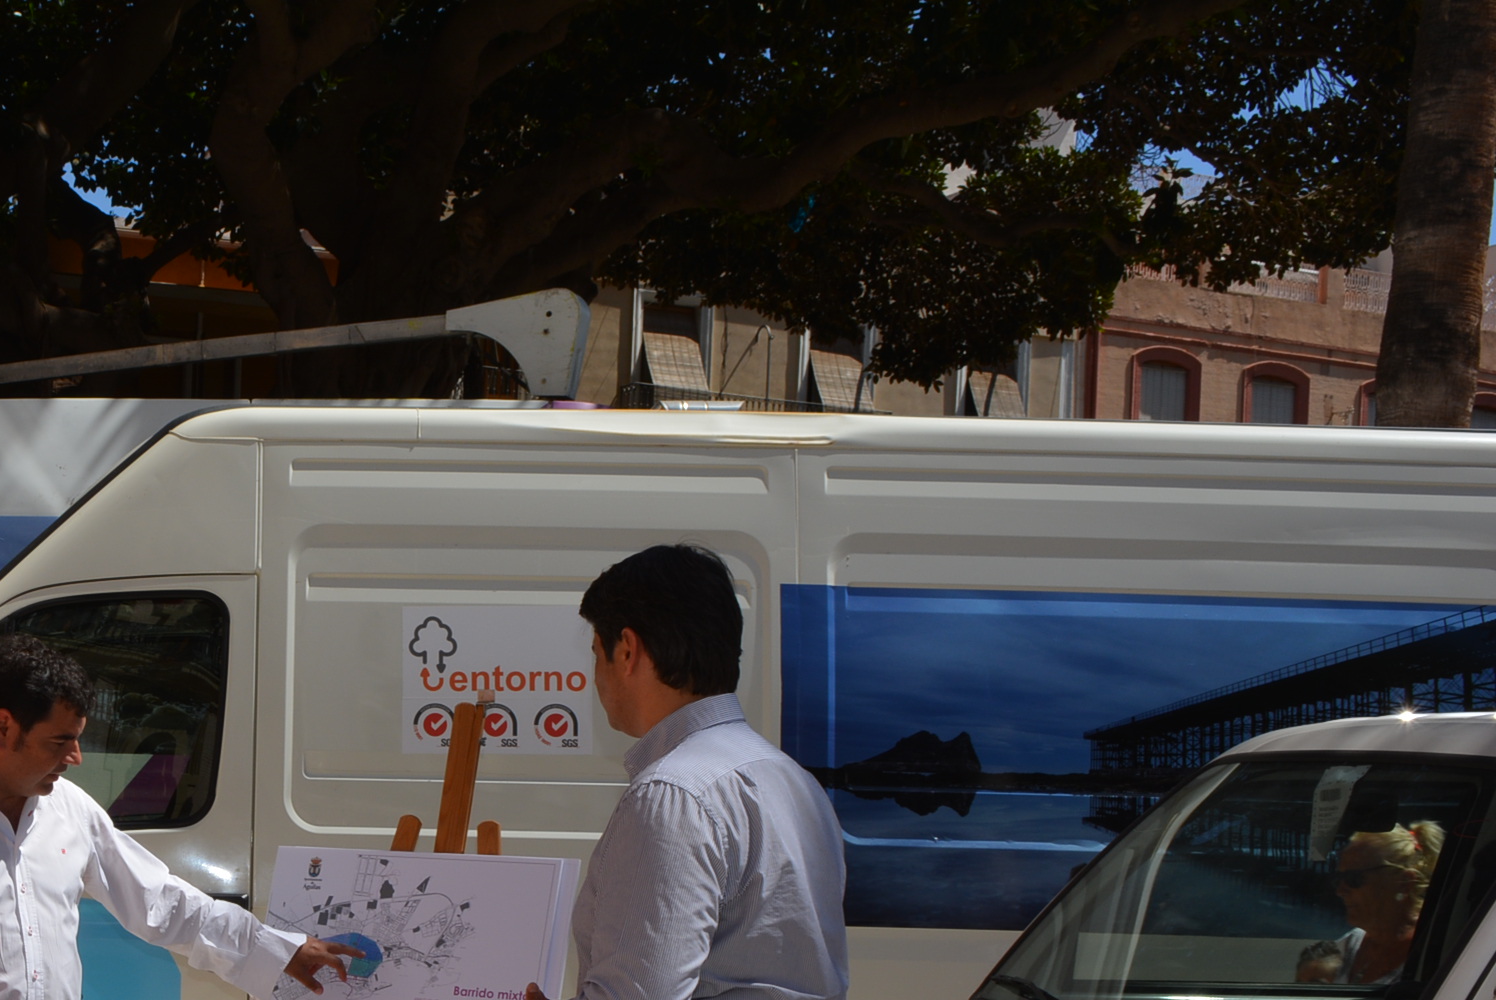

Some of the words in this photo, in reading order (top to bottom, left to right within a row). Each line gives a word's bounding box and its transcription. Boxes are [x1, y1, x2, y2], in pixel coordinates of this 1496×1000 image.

[449, 665, 587, 692] entorno
[501, 738, 518, 747] SGS
[561, 738, 578, 747] SGS
[453, 986, 494, 999] Barrido
